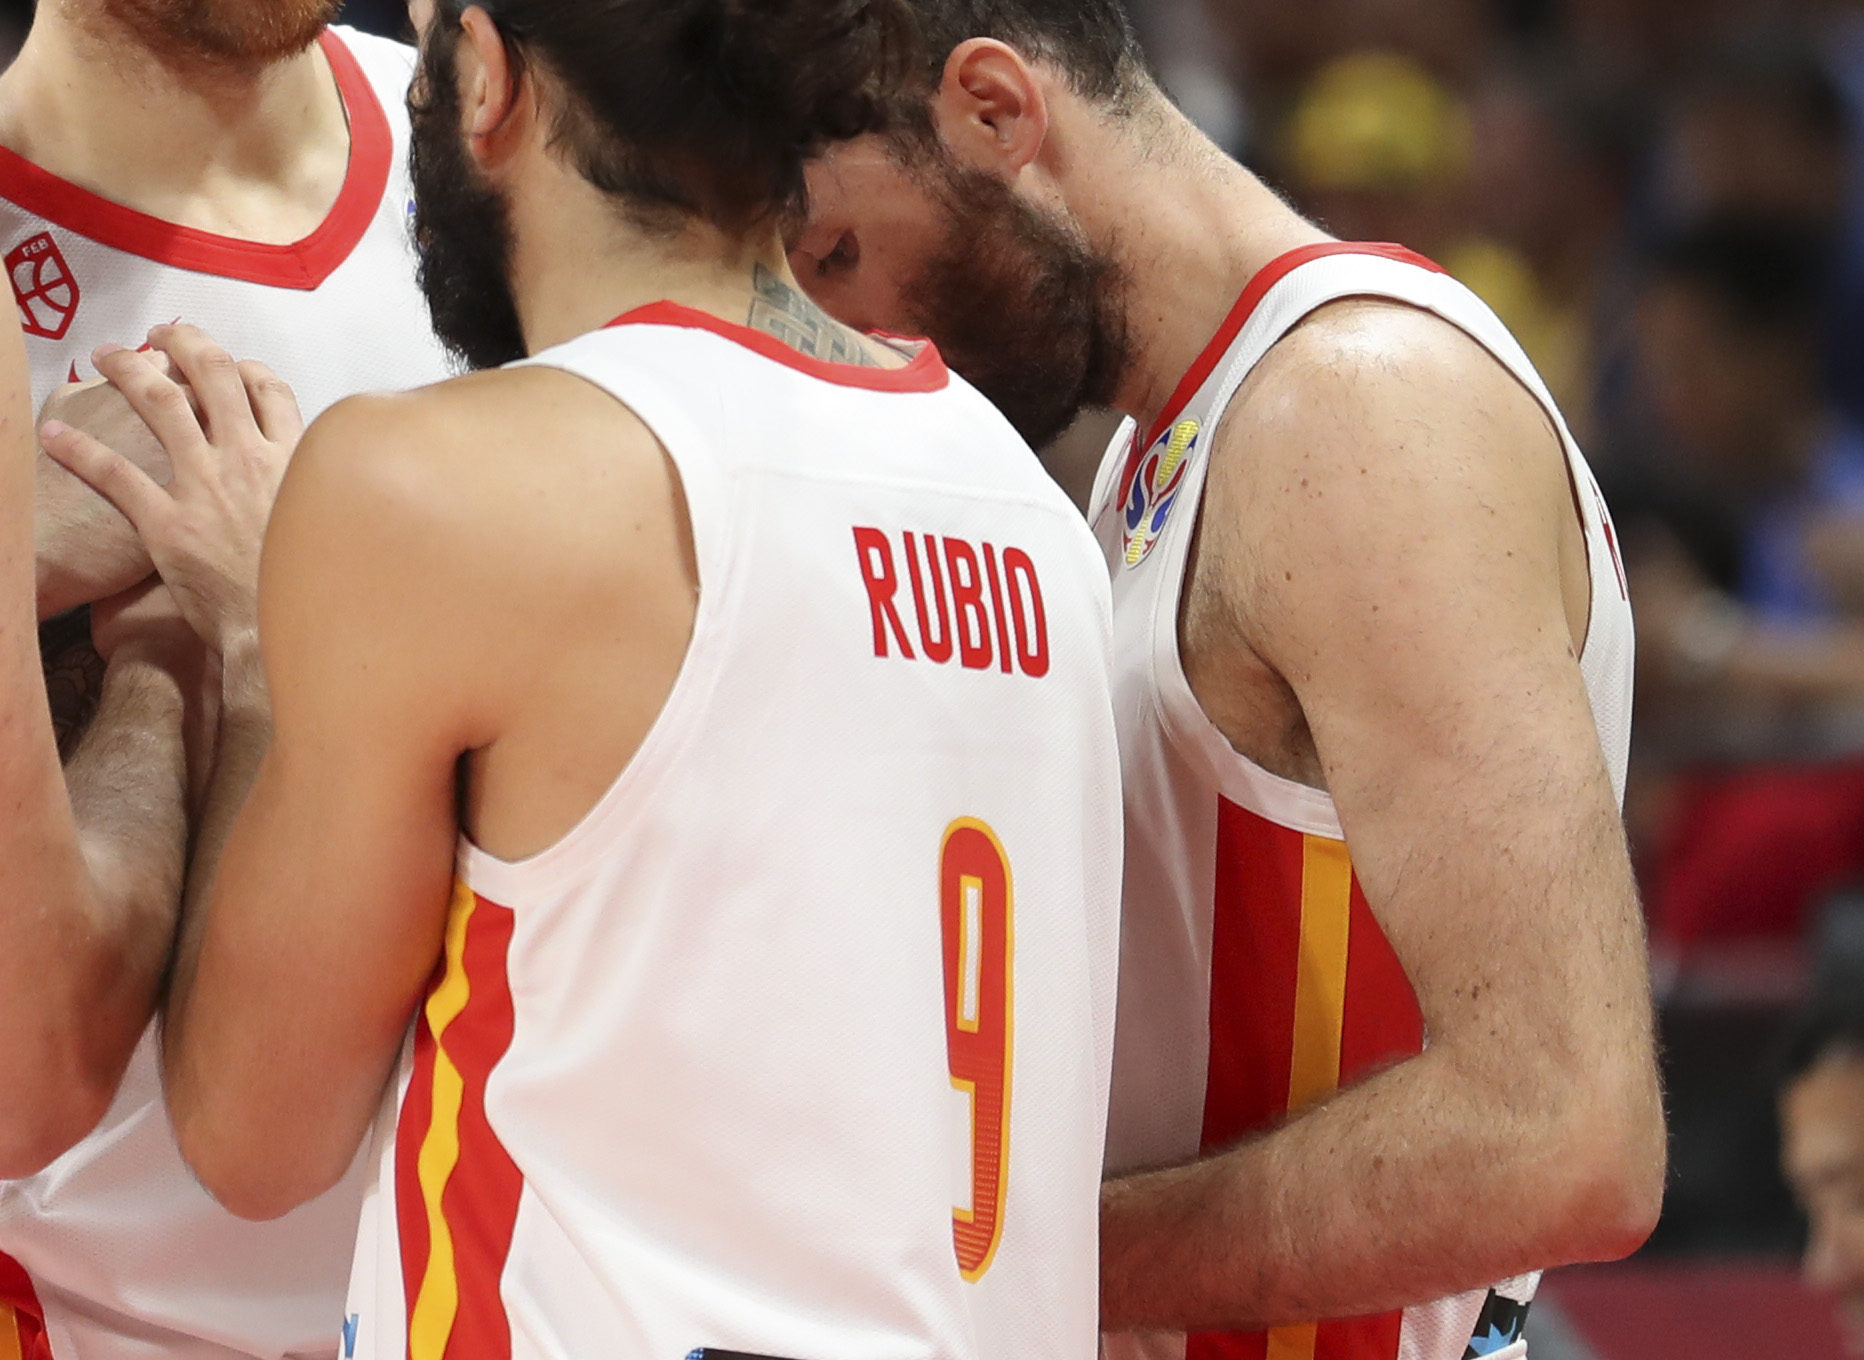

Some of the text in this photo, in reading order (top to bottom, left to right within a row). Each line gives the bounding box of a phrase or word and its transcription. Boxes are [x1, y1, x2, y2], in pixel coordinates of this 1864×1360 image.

[22, 239, 48, 257] FEB
[852, 526, 1050, 679] RUBIO
[939, 815, 1014, 1283] 9
